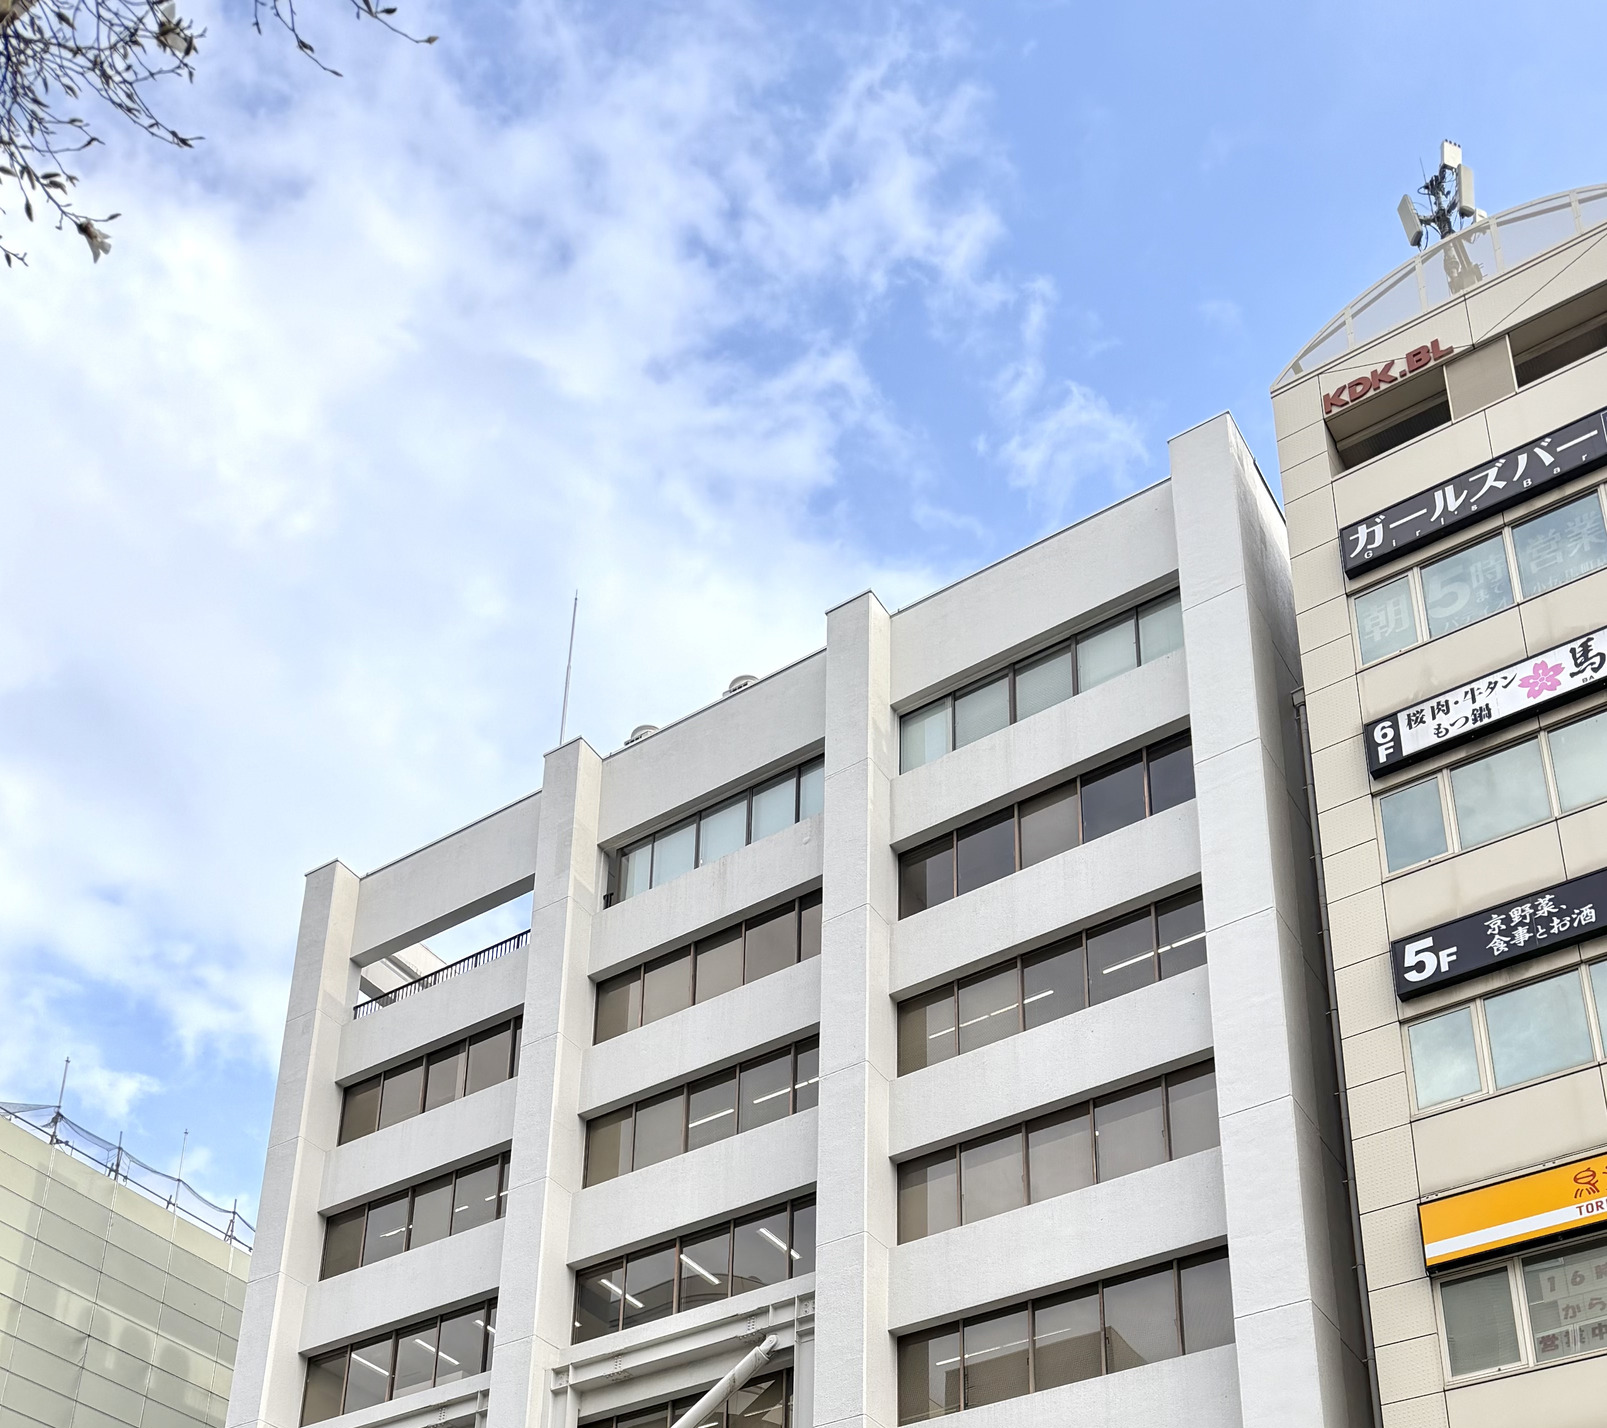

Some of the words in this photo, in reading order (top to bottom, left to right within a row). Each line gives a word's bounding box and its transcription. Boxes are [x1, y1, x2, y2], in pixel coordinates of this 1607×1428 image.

[1323, 338, 1454, 415] KDK.BL
[1350, 429, 1599, 558] ガールズバー
[1523, 453, 1588, 488] Bar
[1433, 703, 1492, 738] もつ鍋
[1486, 903, 1597, 956] 食事とお酒
[1403, 936, 1458, 982] 5F
